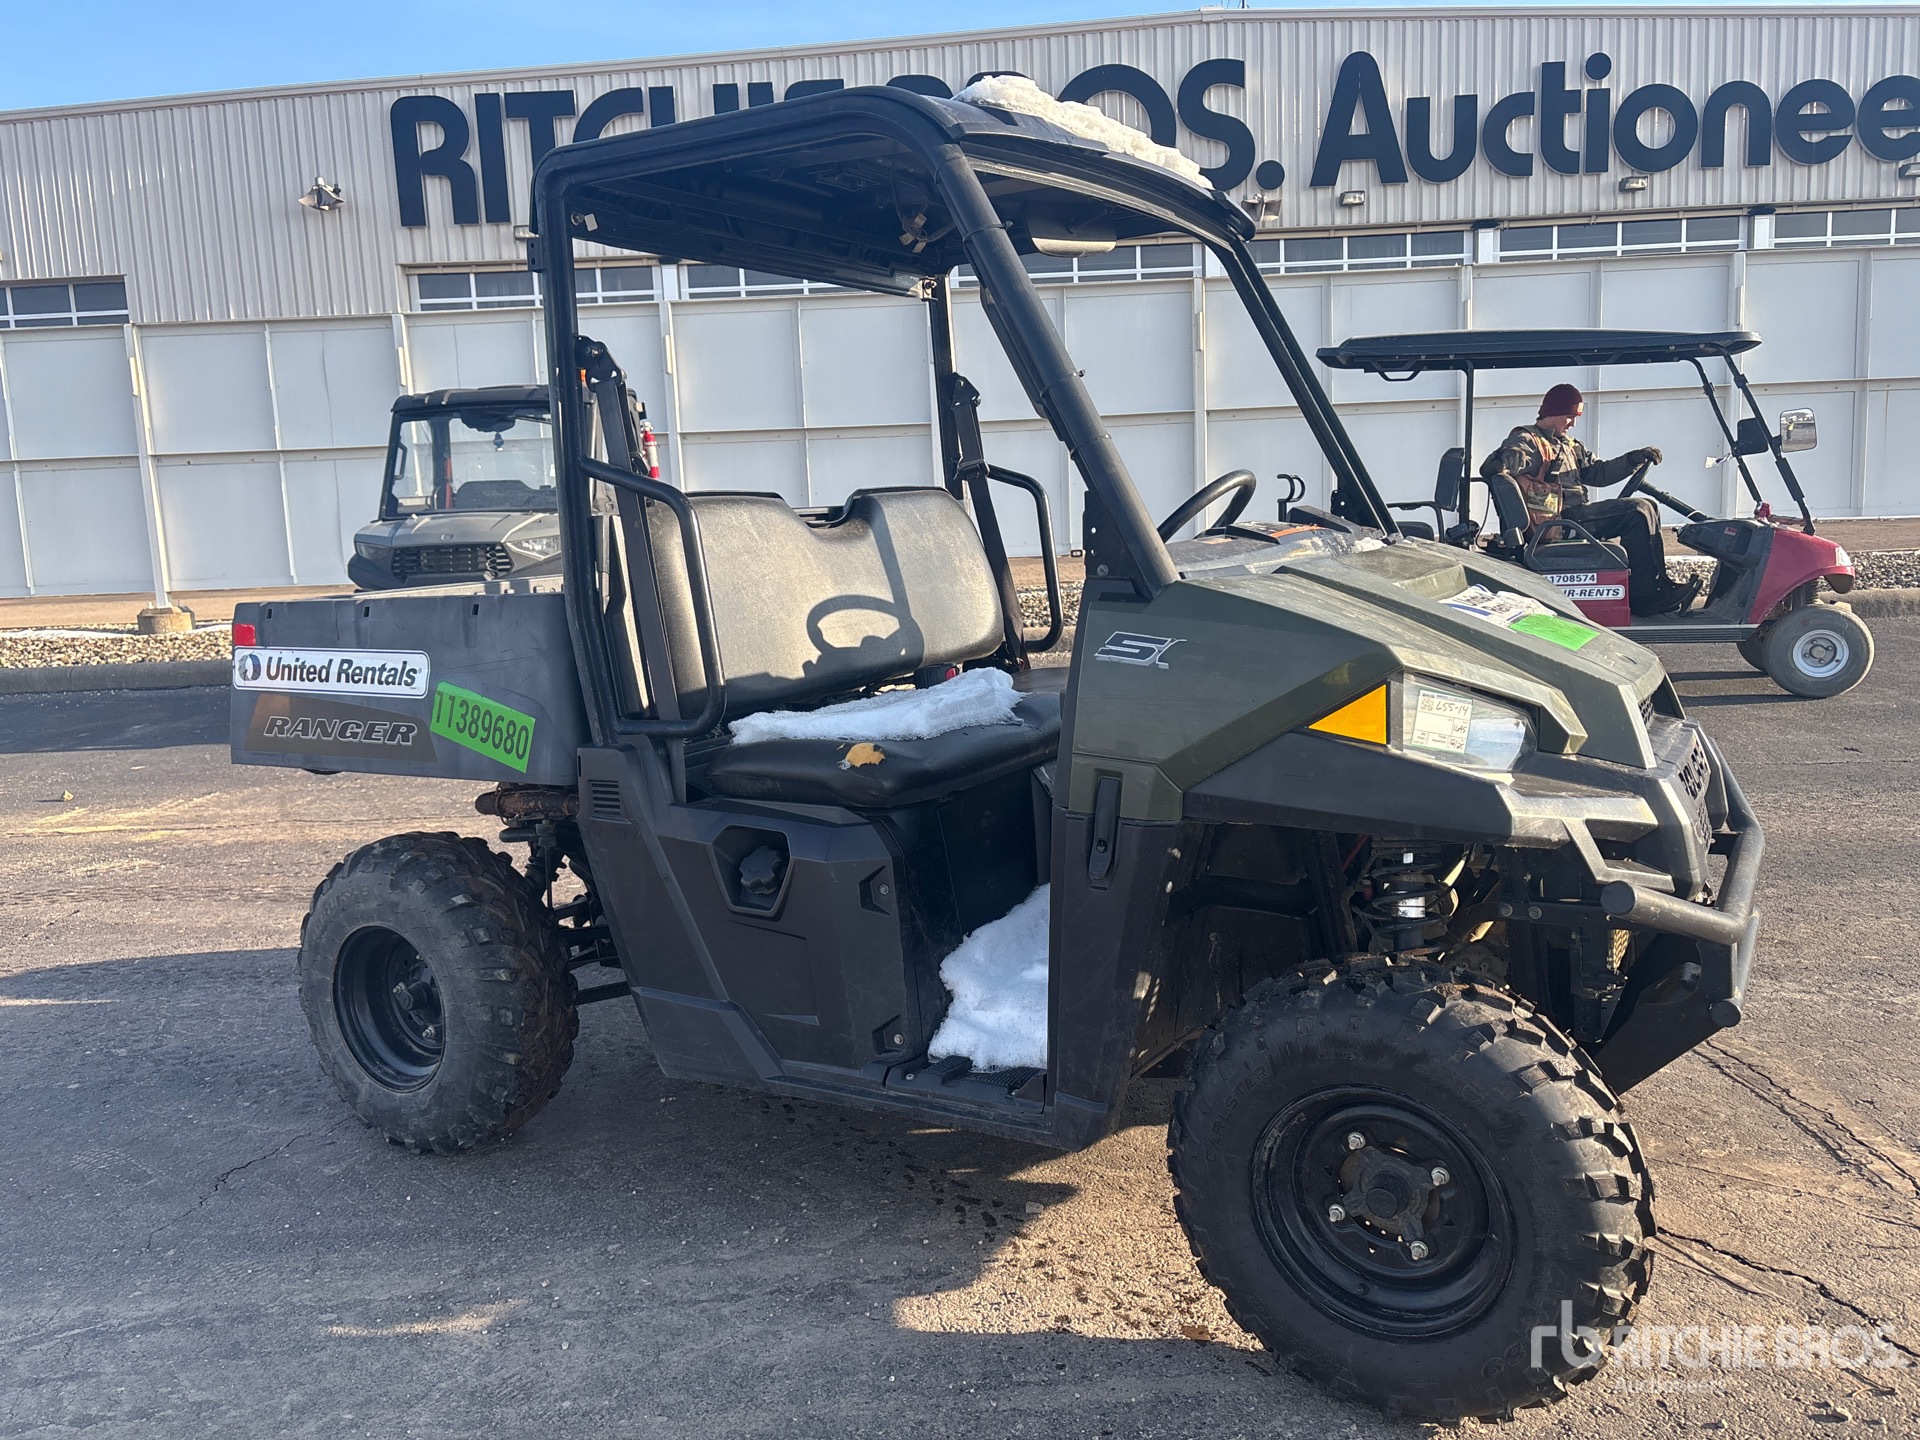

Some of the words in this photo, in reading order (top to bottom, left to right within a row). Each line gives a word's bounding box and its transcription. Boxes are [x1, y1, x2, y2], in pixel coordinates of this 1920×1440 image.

[1563, 588, 1620, 597] R-RENTS
[266, 656, 334, 684] United
[336, 658, 418, 687] Rentals
[264, 716, 420, 746] RANGER
[436, 690, 530, 760] 11389680
[1206, 1065, 1270, 1162] CARLSTAR
